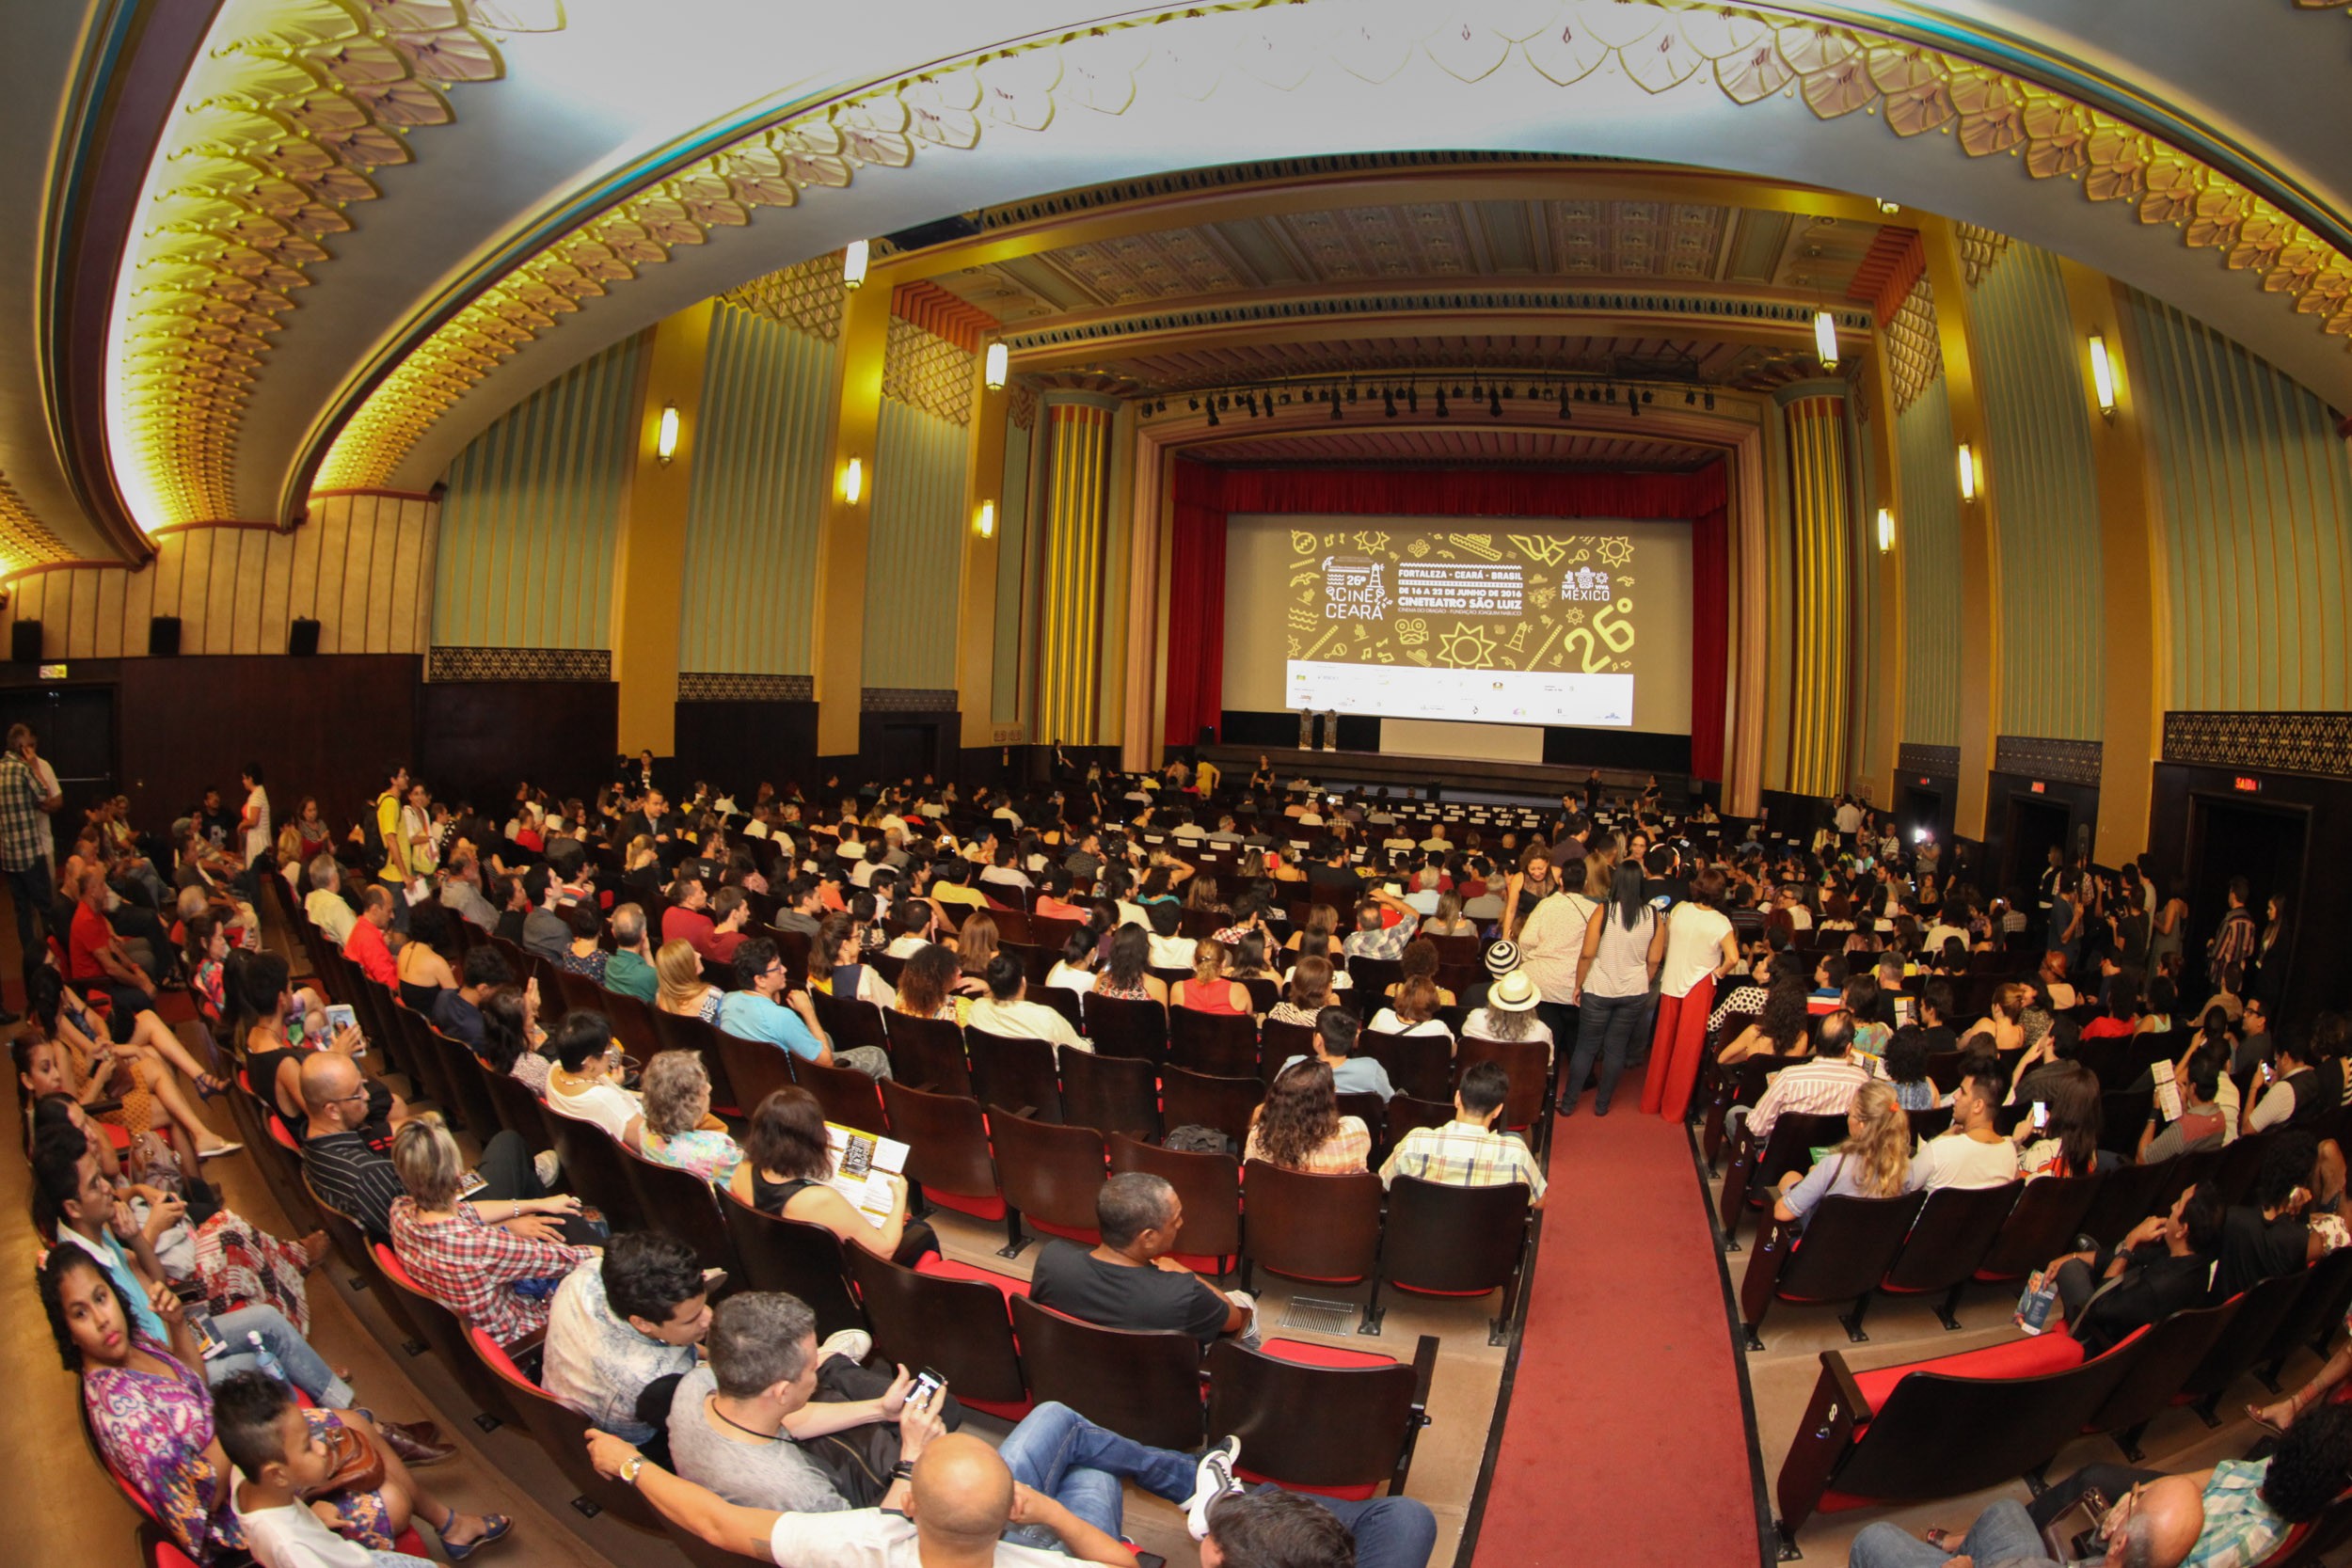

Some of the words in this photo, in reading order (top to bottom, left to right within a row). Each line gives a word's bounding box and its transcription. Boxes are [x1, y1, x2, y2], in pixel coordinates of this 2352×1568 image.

[1398, 569, 1447, 578] FORTALEZA
[1454, 569, 1484, 579] CEARÁ
[1491, 571, 1523, 580] BRASIL
[1336, 587, 1374, 603] CINE
[1423, 587, 1431, 595] A
[1444, 588, 1455, 596] DE
[1561, 587, 1610, 601] MÉXICO
[1398, 596, 1467, 609] CINETEATRO
[1469, 596, 1494, 610] SÃO
[1497, 599, 1522, 610] LUIZ
[1326, 601, 1383, 621] CEARÁ
[1829, 1403, 1838, 1422] S
